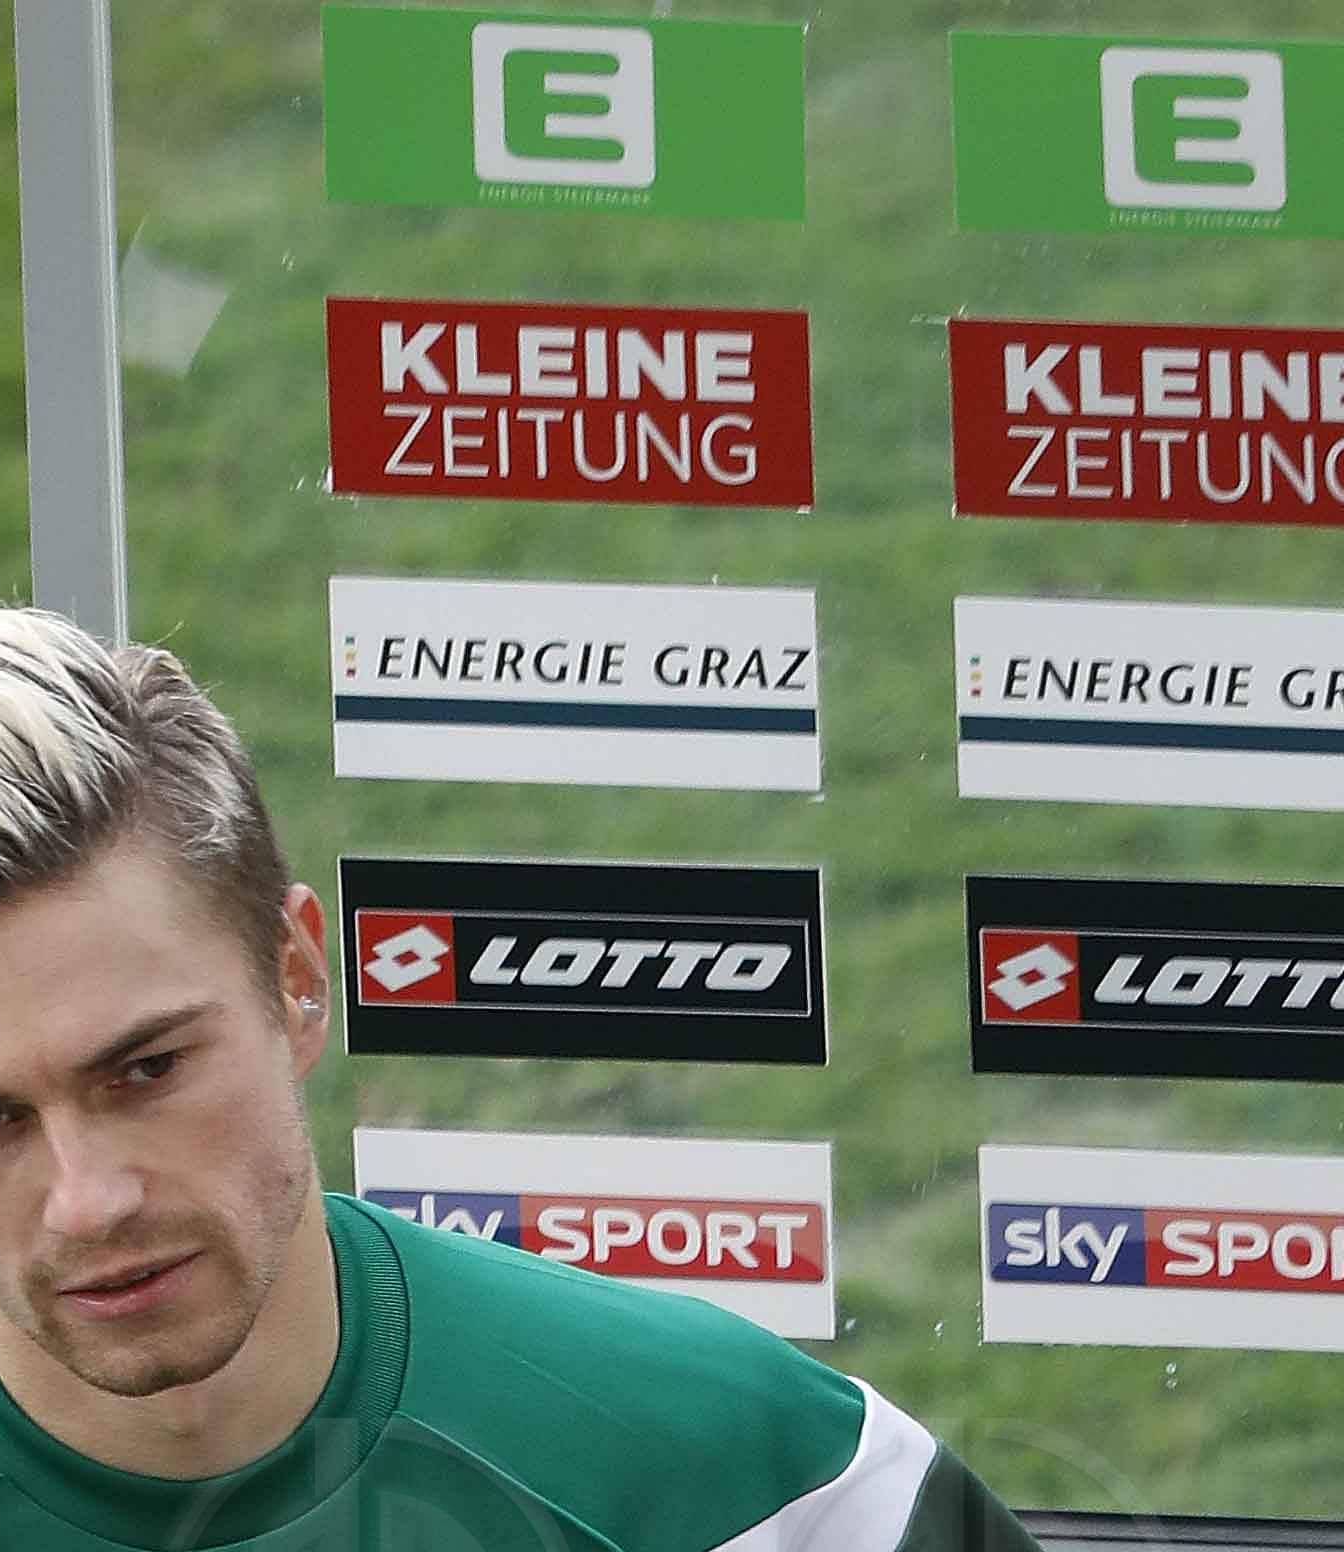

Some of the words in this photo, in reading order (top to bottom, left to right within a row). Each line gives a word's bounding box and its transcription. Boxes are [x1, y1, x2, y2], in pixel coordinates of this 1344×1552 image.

[381, 321, 755, 402] KLEINE
[383, 403, 758, 486] ZEITUNG
[376, 636, 627, 686] ENERGIE
[654, 645, 814, 691] GRAZ
[1002, 657, 1255, 708] ENERGIE
[469, 935, 793, 992] LOTTO
[536, 1207, 809, 1270] SPORT
[1003, 1207, 1130, 1283] sky
